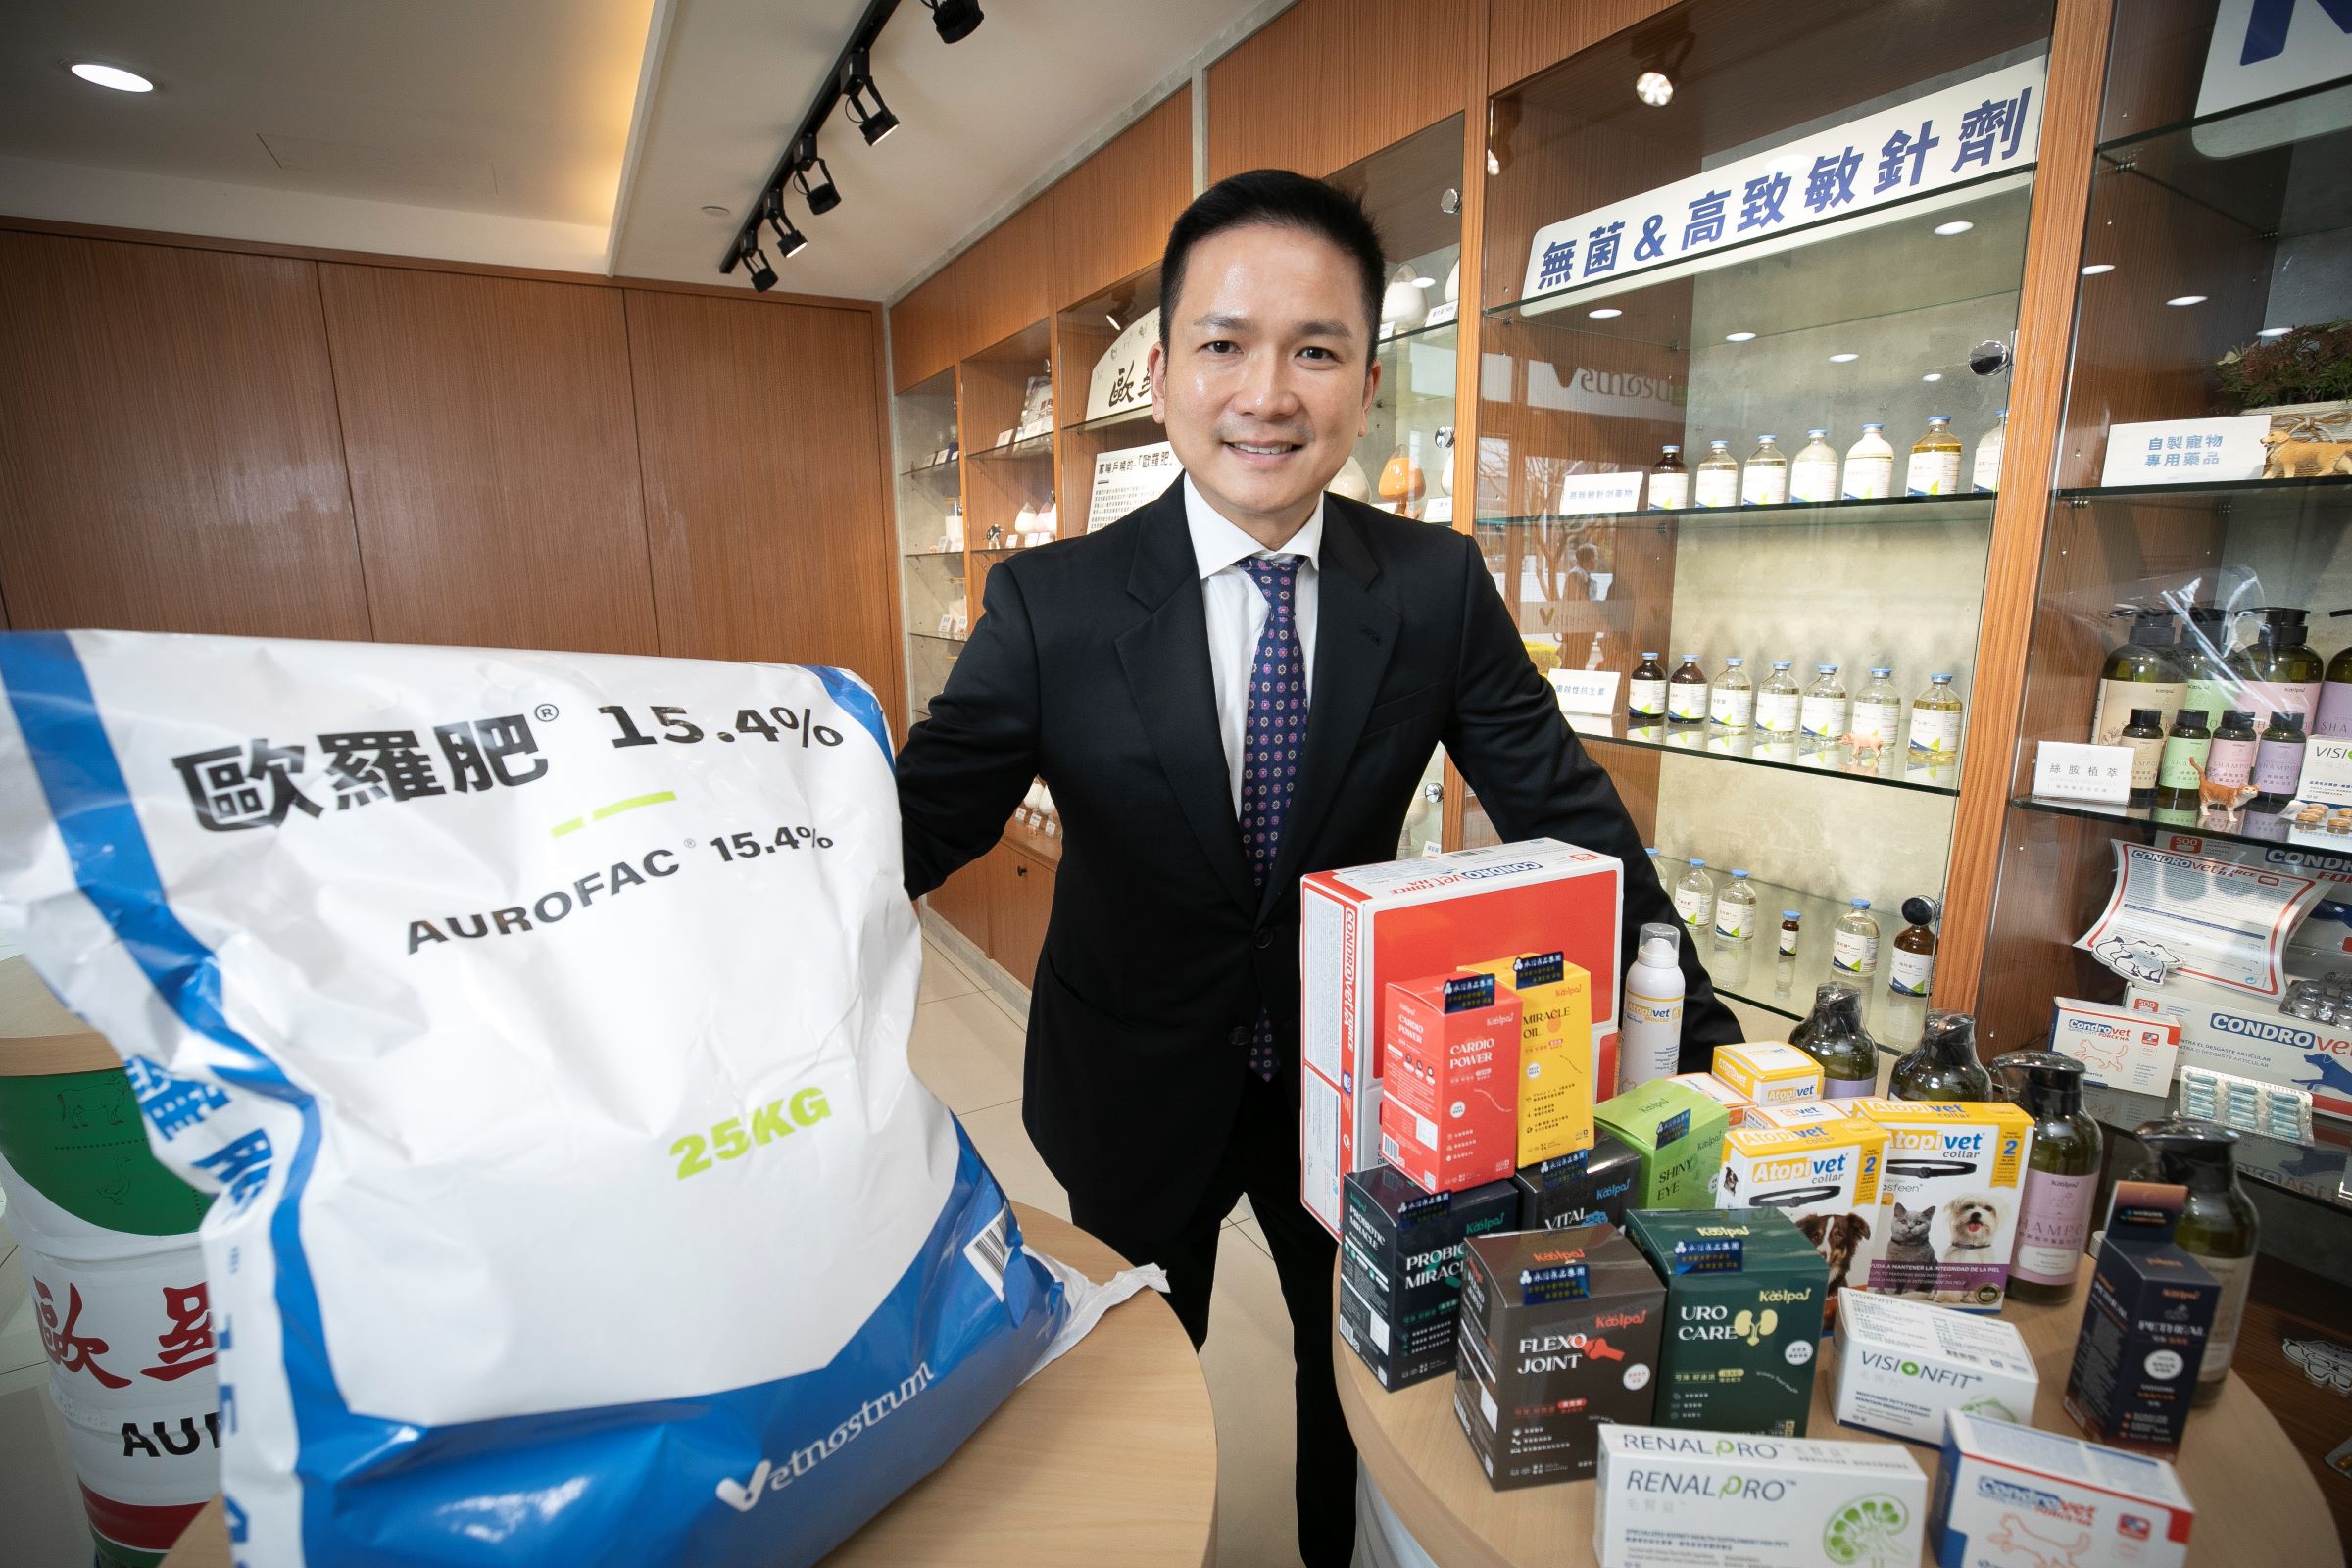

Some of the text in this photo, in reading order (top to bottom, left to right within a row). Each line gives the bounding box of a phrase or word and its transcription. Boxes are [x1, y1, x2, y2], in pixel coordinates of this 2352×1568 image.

[1538, 86, 2032, 291] 無菌&高致敏針劑
[2148, 434, 2223, 451] 自製寵物
[2145, 452, 2220, 466] 專用藥品
[599, 704, 844, 749] 15.4%
[2316, 746, 2352, 760] VISI
[710, 826, 834, 862] 15.4%
[2174, 836, 2197, 846] 500
[2132, 850, 2219, 875] CONDROvet
[1522, 1006, 1571, 1026] MIRACLE
[1523, 1027, 1541, 1040] OIL
[1450, 1037, 1494, 1055] CARDIO
[1449, 1052, 1493, 1069] POWER
[1768, 1084, 1815, 1101] Atopivet
[669, 1086, 832, 1181] 25KG
[1942, 1150, 1981, 1159] collar
[2003, 1140, 2018, 1155] 2
[1658, 1157, 1693, 1184] SHINY
[1753, 1153, 1847, 1183] Atopivet
[1864, 1156, 1877, 1173] 2
[1812, 1173, 1844, 1185] collar
[1657, 1182, 1680, 1200] EYE
[1544, 1207, 1587, 1231] VITAL
[1406, 1241, 1466, 1271] PROBIO
[1404, 1259, 1464, 1290] MIRAC
[1681, 1304, 1728, 1321] URO
[1678, 1325, 1739, 1341] CARE
[1520, 1333, 1587, 1354] FLEXO
[1517, 1352, 1583, 1375] JOINT
[715, 1362, 934, 1512] Vetnostrum
